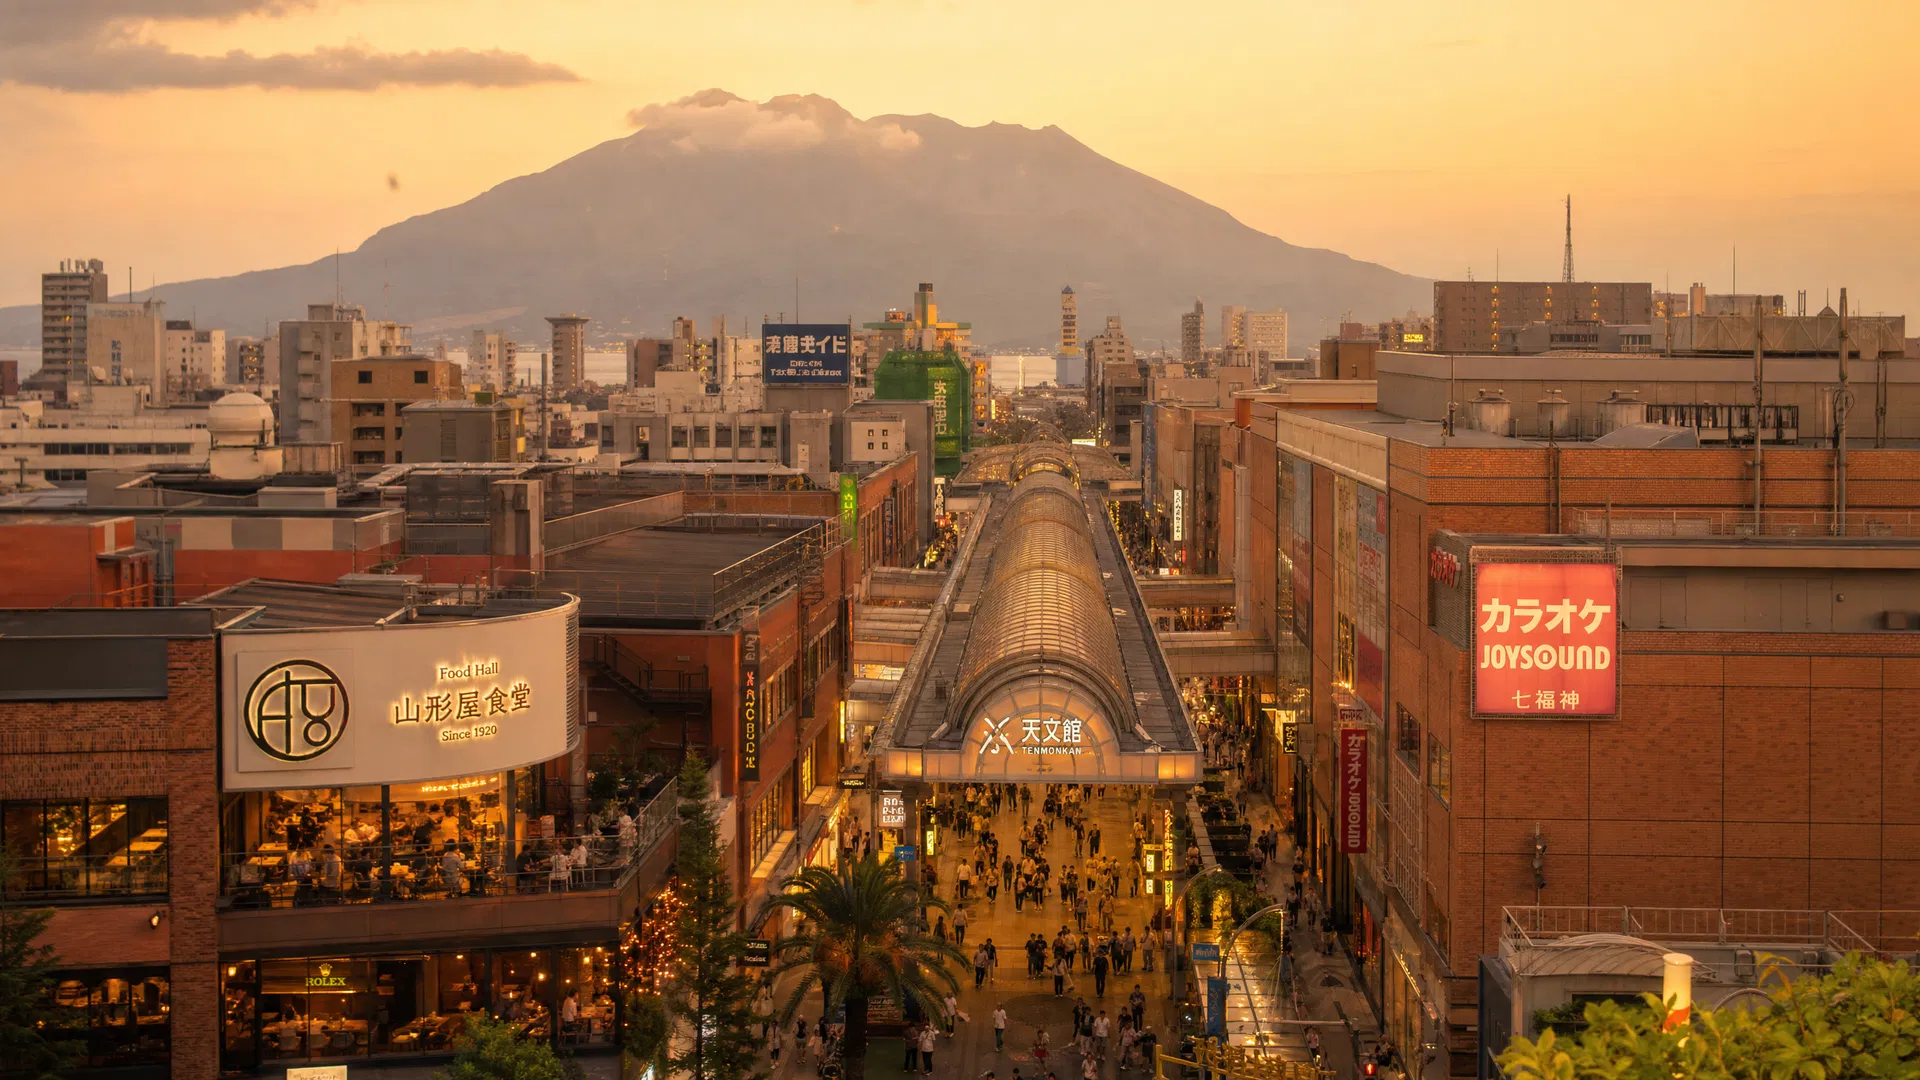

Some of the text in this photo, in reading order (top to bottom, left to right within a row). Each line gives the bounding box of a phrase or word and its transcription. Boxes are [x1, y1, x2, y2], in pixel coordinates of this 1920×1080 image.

[1480, 598, 1611, 634] カラオケ
[1480, 644, 1611, 670] JOYSOUND
[440, 662, 498, 680] Food Hall
[395, 683, 531, 724] 山形屋食堂
[1512, 690, 1579, 710] 七福神
[442, 725, 498, 742] Since 1920
[1022, 717, 1082, 743] 天文館
[1022, 746, 1082, 755] TENMONKAN
[1347, 733, 1362, 790] カラオケ
[305, 977, 346, 987] ROLEX
